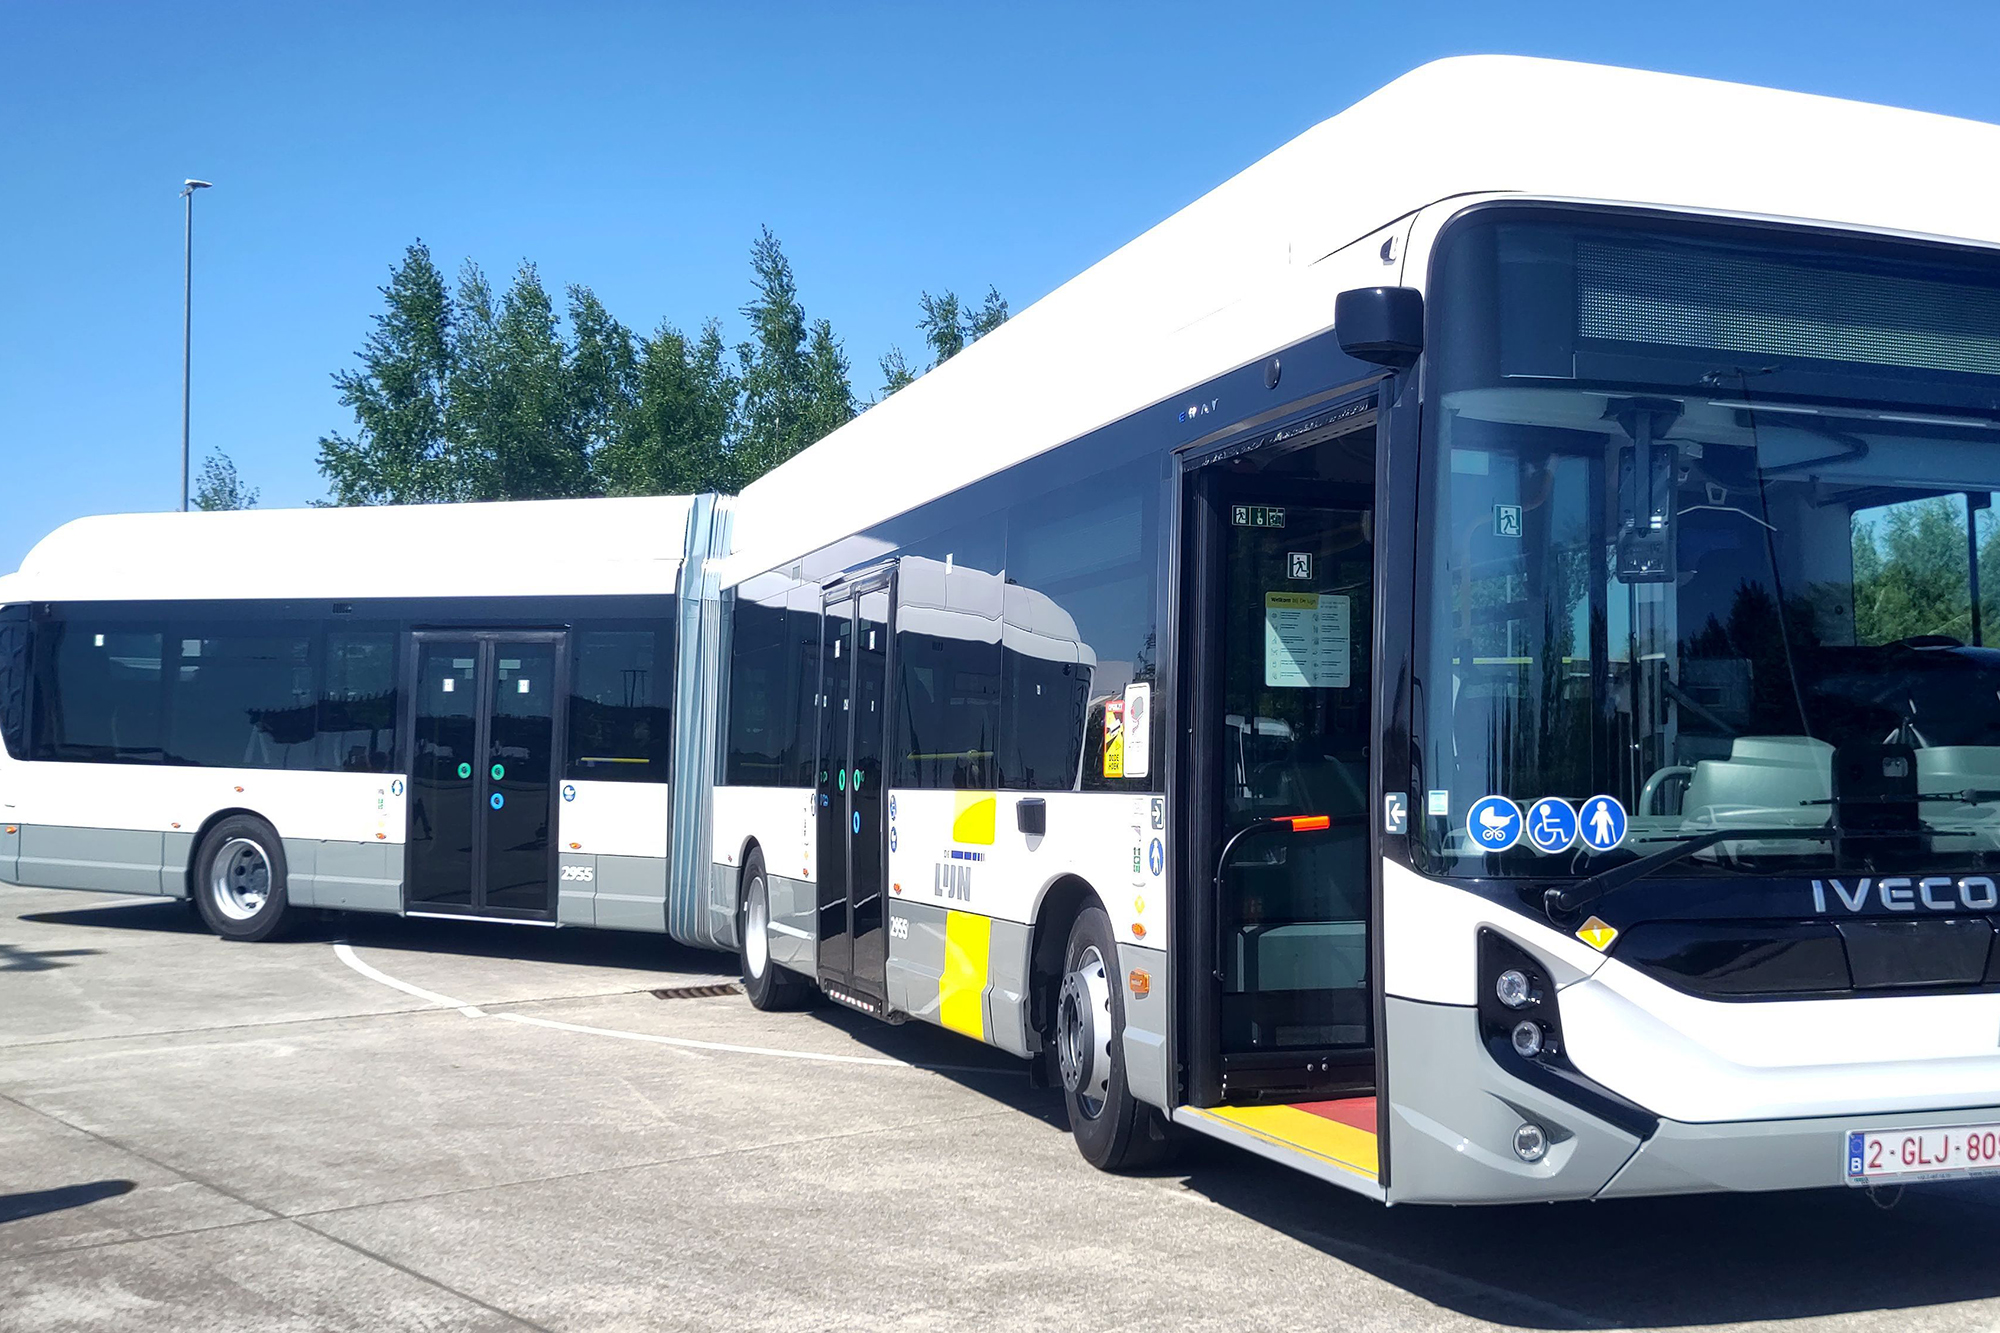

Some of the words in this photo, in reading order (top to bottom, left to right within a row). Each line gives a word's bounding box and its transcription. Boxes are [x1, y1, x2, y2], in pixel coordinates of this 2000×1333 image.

[1811, 876, 1998, 913] IVECO
[1851, 1157, 1861, 1172] B
[1868, 1131, 2000, 1169] 2-GLJ-80
